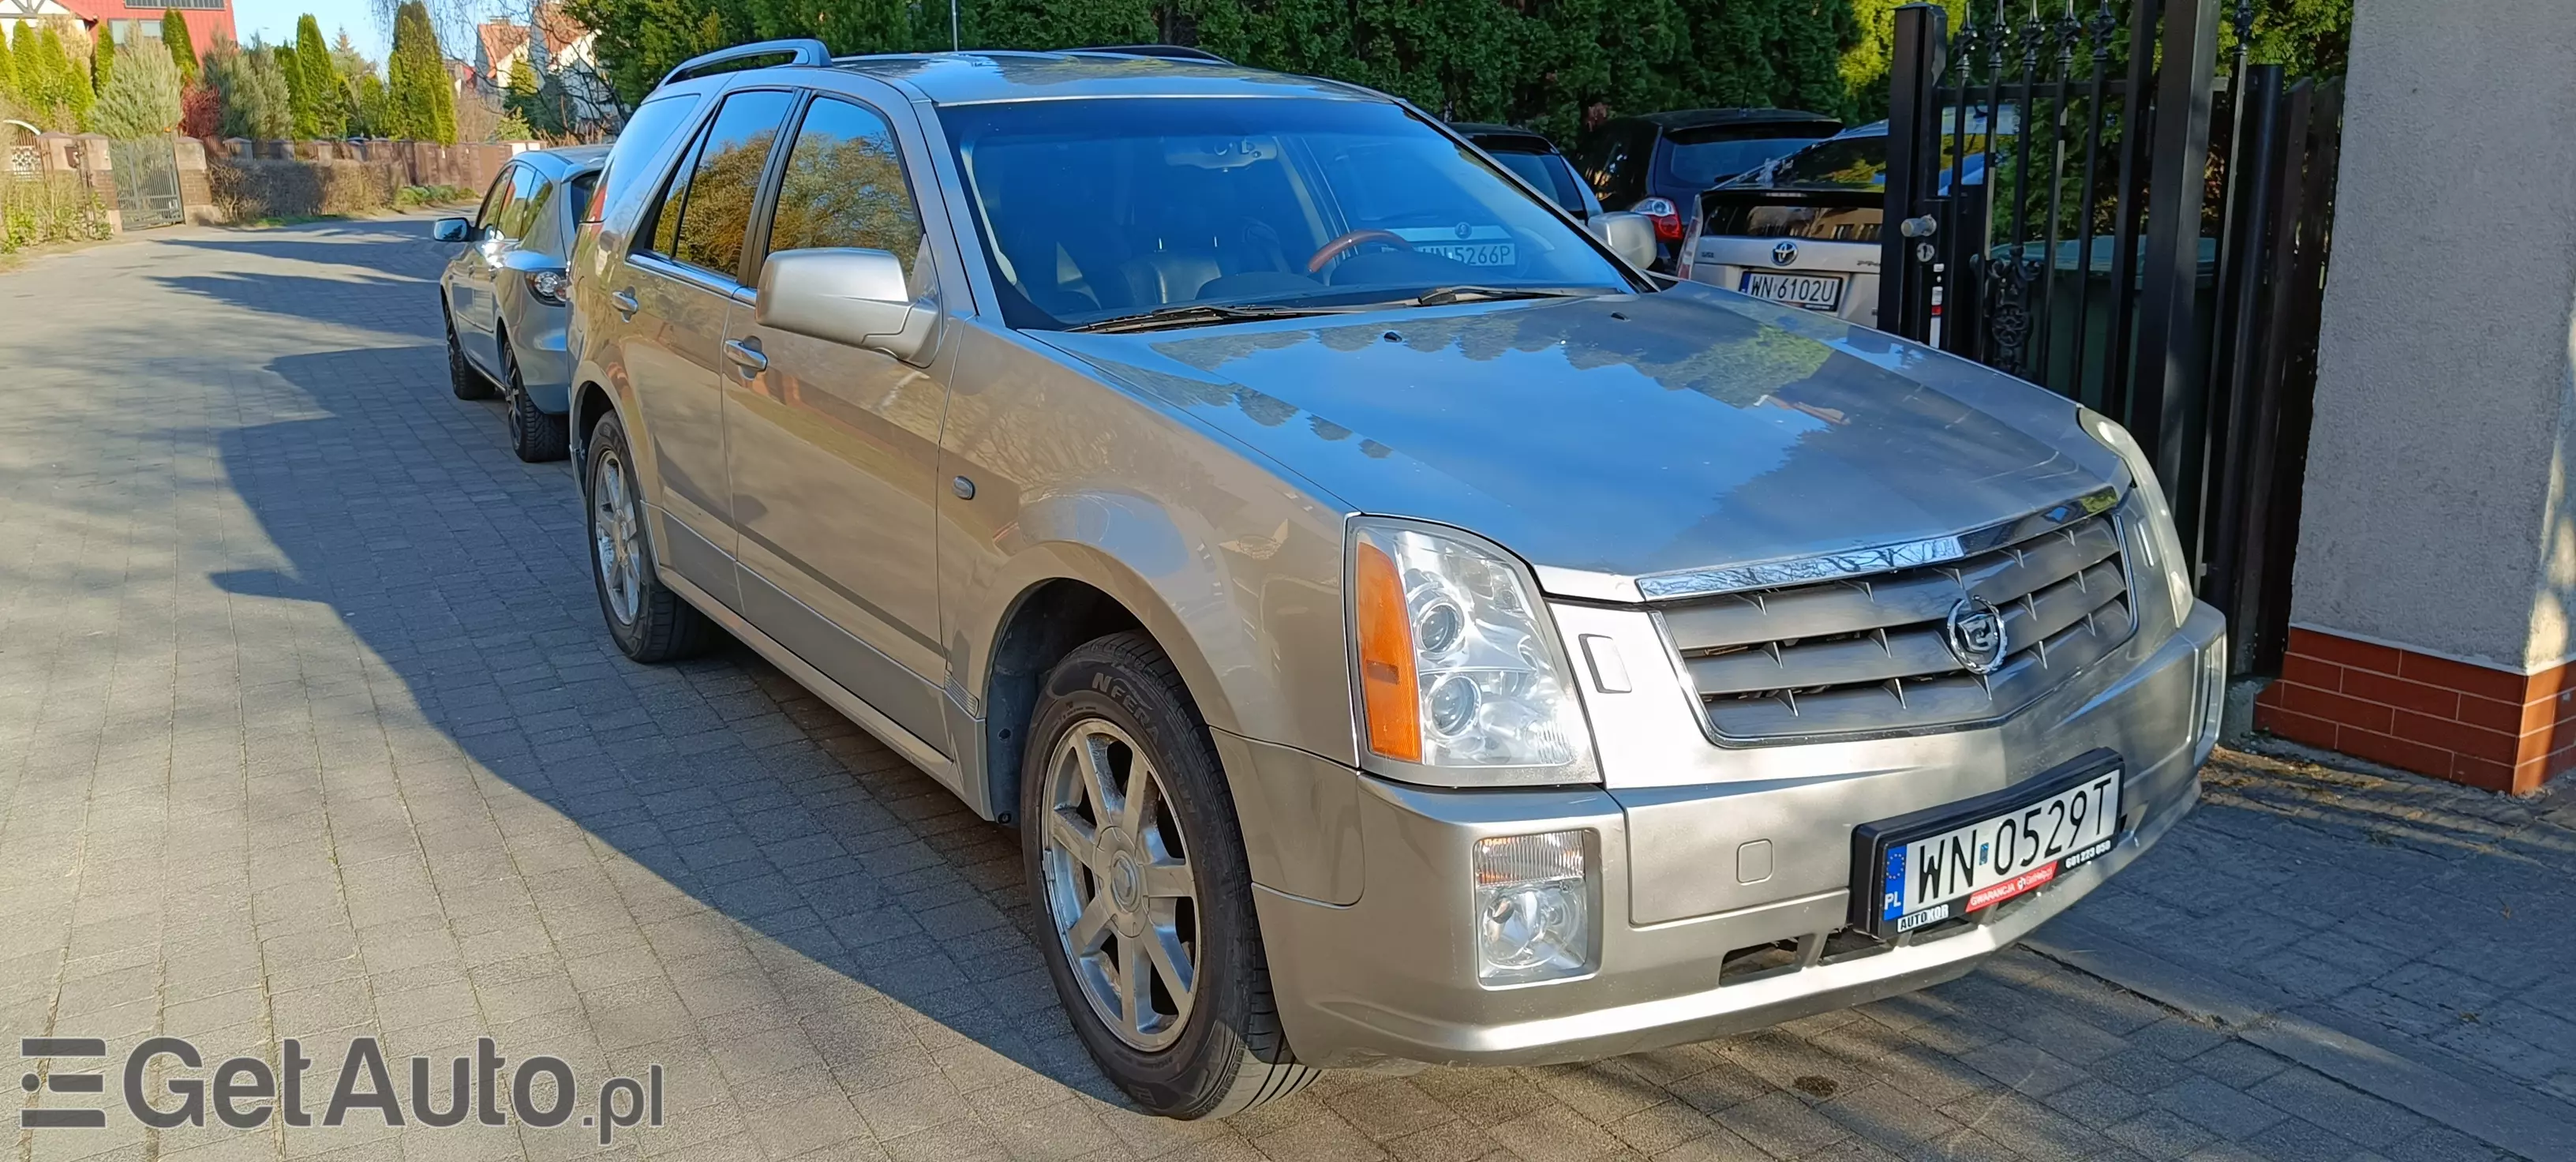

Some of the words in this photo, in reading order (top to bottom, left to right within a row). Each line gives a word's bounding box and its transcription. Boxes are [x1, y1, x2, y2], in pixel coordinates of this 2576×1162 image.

[1455, 246, 1511, 265] 5266P
[1751, 276, 1774, 299] WN
[1777, 279, 1836, 302] 6102U
[1884, 890, 1901, 911] PL
[1919, 829, 1977, 904] WN
[1994, 778, 2112, 876] 0529T
